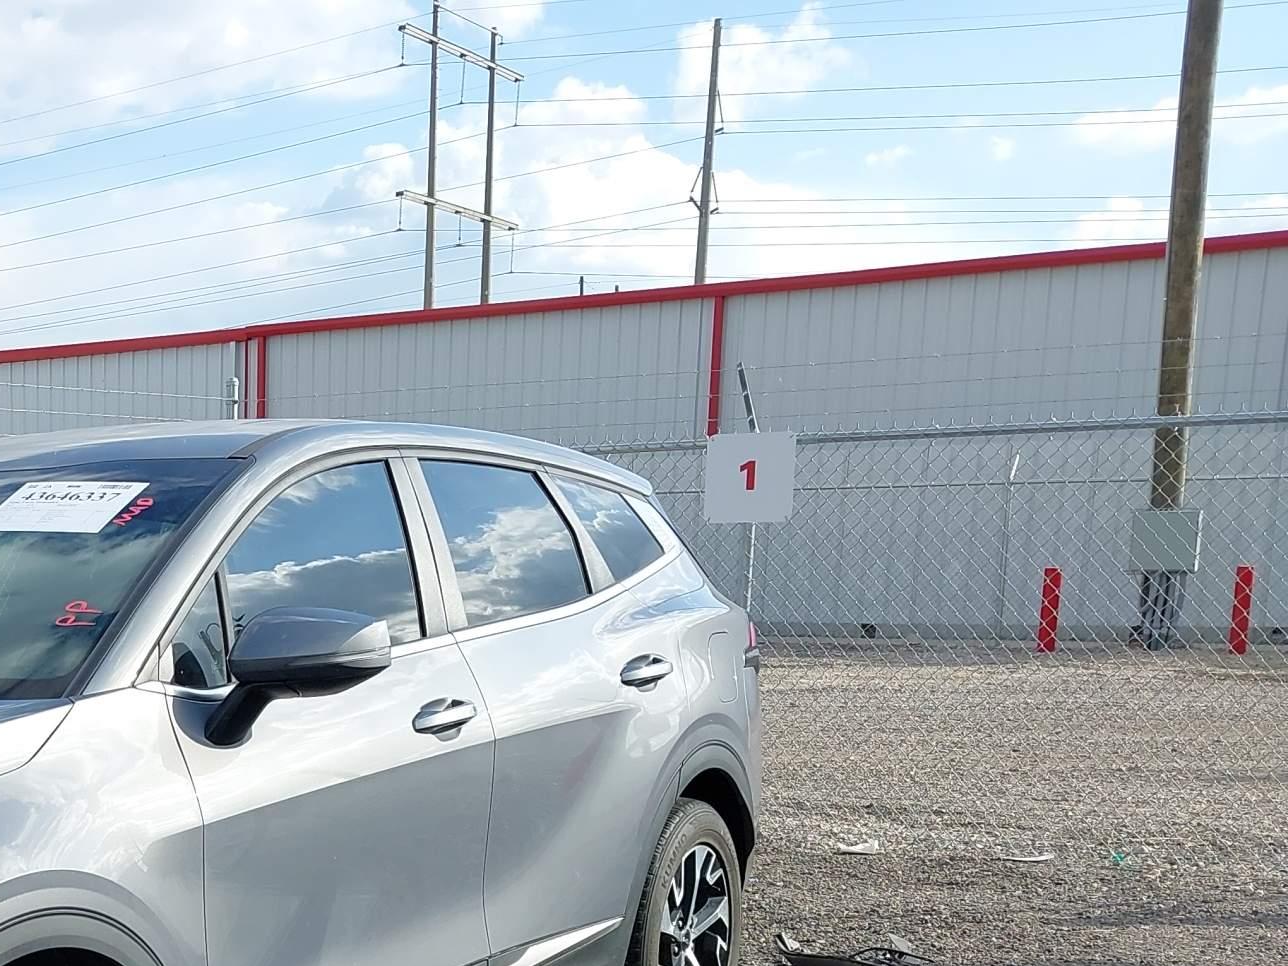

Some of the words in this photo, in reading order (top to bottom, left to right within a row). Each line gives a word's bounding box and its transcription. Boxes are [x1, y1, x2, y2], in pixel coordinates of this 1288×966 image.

[739, 459, 757, 492] 1
[21, 491, 121, 502] 43646337
[661, 833, 688, 890] KUMHO
